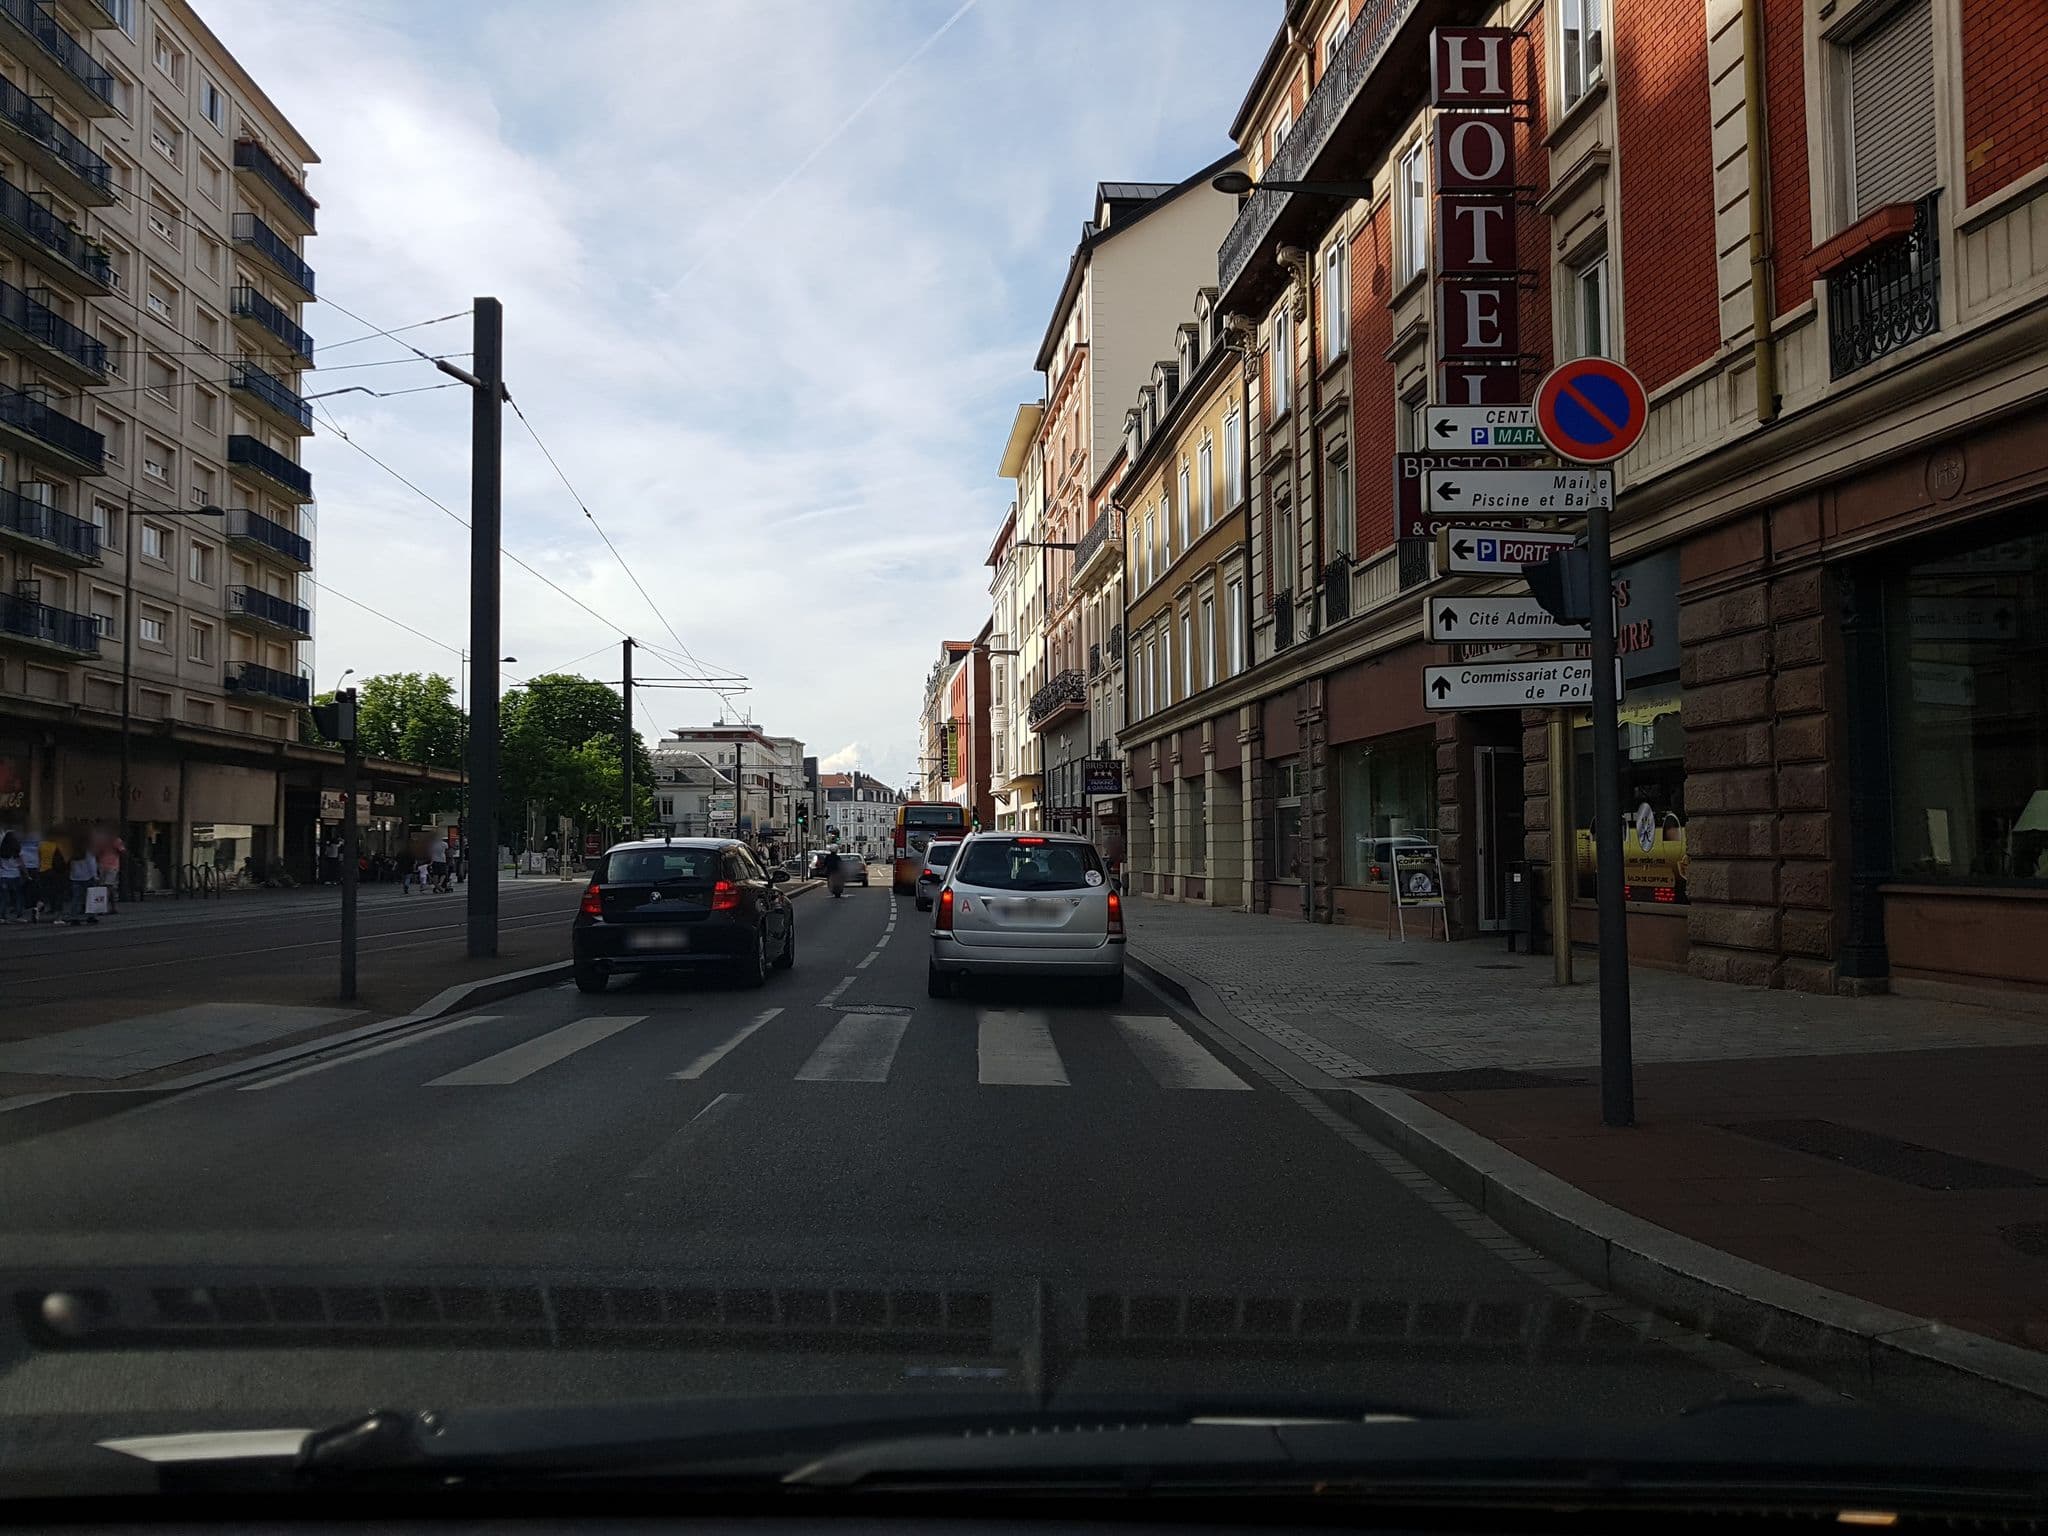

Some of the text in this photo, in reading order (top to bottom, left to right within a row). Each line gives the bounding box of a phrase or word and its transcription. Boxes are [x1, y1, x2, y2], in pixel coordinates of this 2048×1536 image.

[1498, 429, 1542, 443] MAR
[1553, 475, 1607, 489] Maire
[1472, 493, 1608, 507] Piscine et Bais
[1503, 543, 1551, 562] PORTE
[1469, 611, 1499, 626] Cité
[1618, 618, 1651, 655] URE
[1461, 665, 1591, 685] Commissariat Cen
[1525, 685, 1545, 699] de
[961, 899, 972, 913] A
